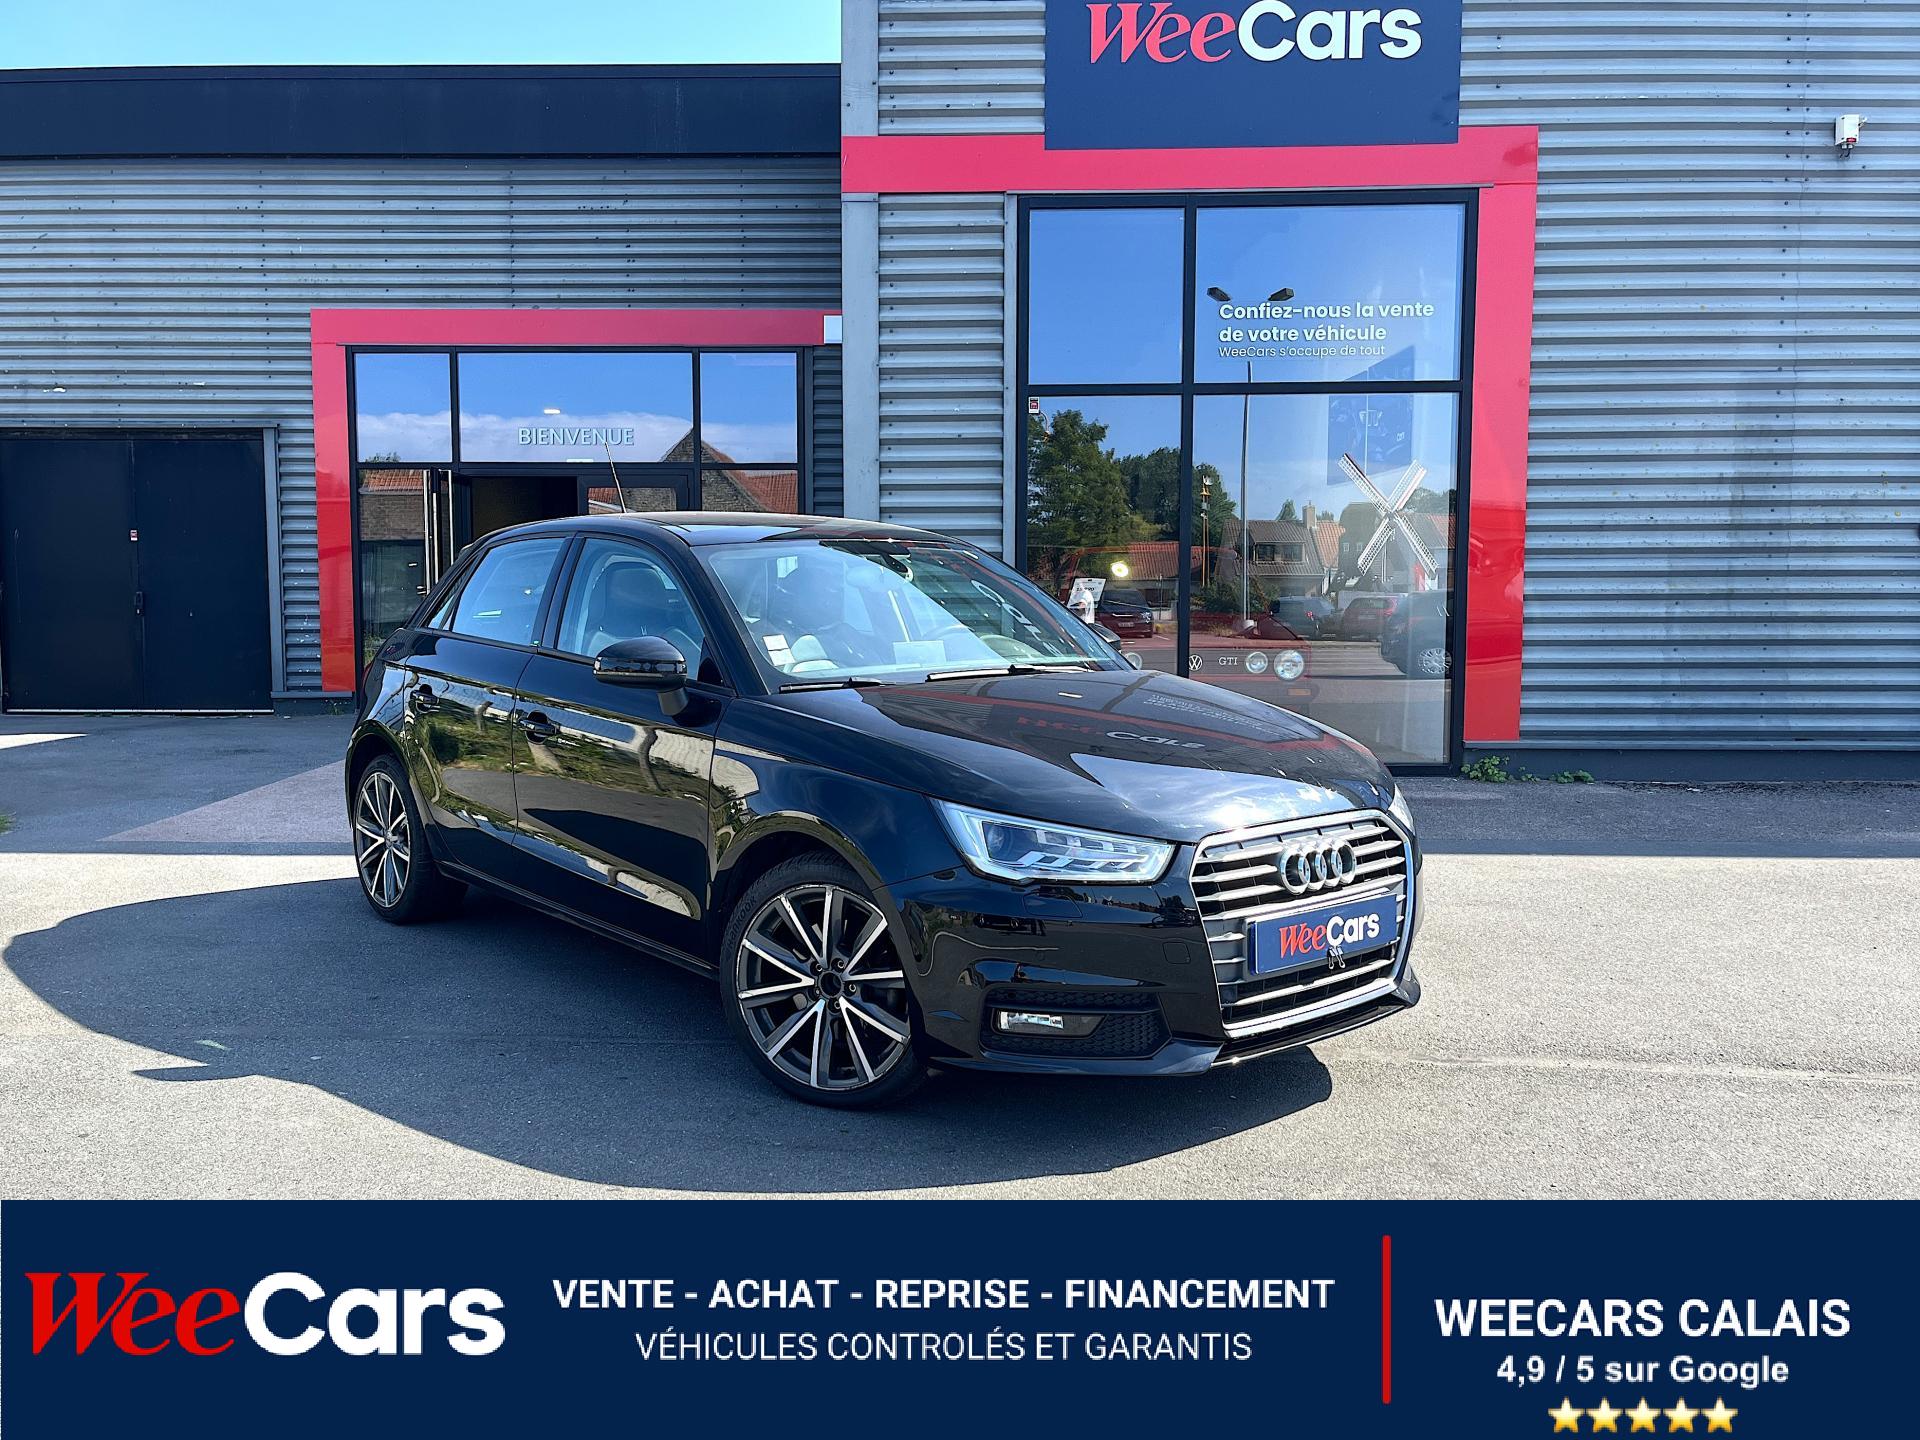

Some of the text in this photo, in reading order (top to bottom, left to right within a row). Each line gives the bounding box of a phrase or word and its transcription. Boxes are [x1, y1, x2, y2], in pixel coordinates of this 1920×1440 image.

[1086, 0, 1422, 63] WeeCars
[1219, 302, 1434, 319] Confiez-nous la vente
[1219, 324, 1386, 342] de votre véhicule
[1219, 346, 1276, 357] WeeCars
[1340, 345, 1356, 356] de
[1360, 345, 1385, 355] tout
[519, 427, 634, 445] BIENVENUE
[1218, 657, 1238, 666] GTI
[1279, 912, 1380, 959] WeeCars
